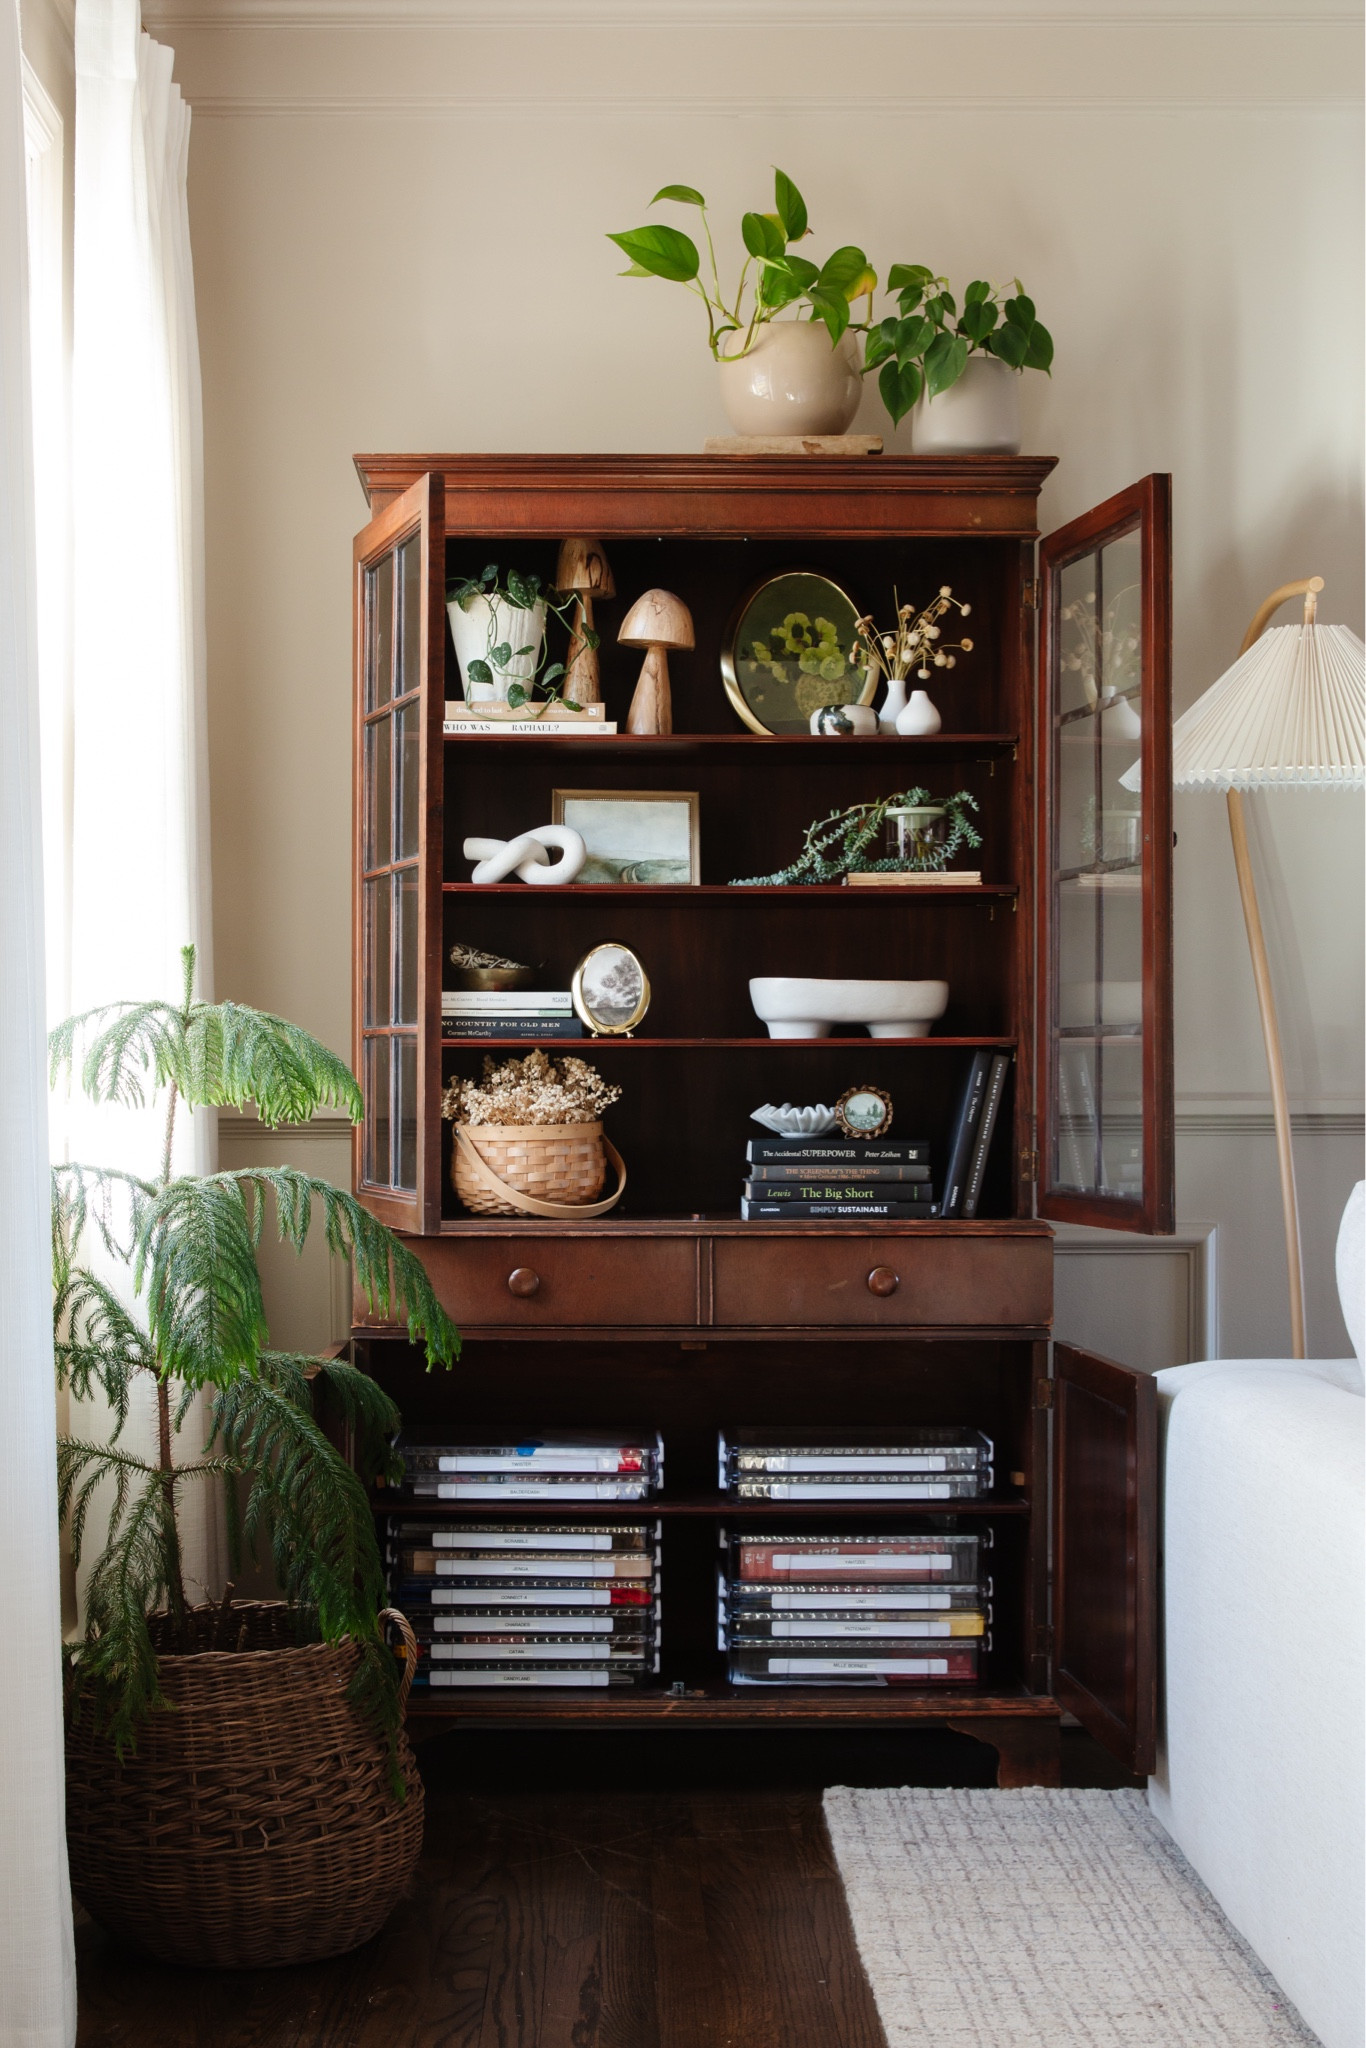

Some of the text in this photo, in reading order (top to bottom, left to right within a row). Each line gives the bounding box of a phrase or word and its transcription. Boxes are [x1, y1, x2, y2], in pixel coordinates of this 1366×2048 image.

[512, 724, 559, 732] RAPHAEL?
[982, 1102, 994, 1139] HAPPENING
[802, 1150, 856, 1158] SUPERPOWER
[767, 1188, 792, 1197] Lewis
[800, 1187, 874, 1200] The Big Short
